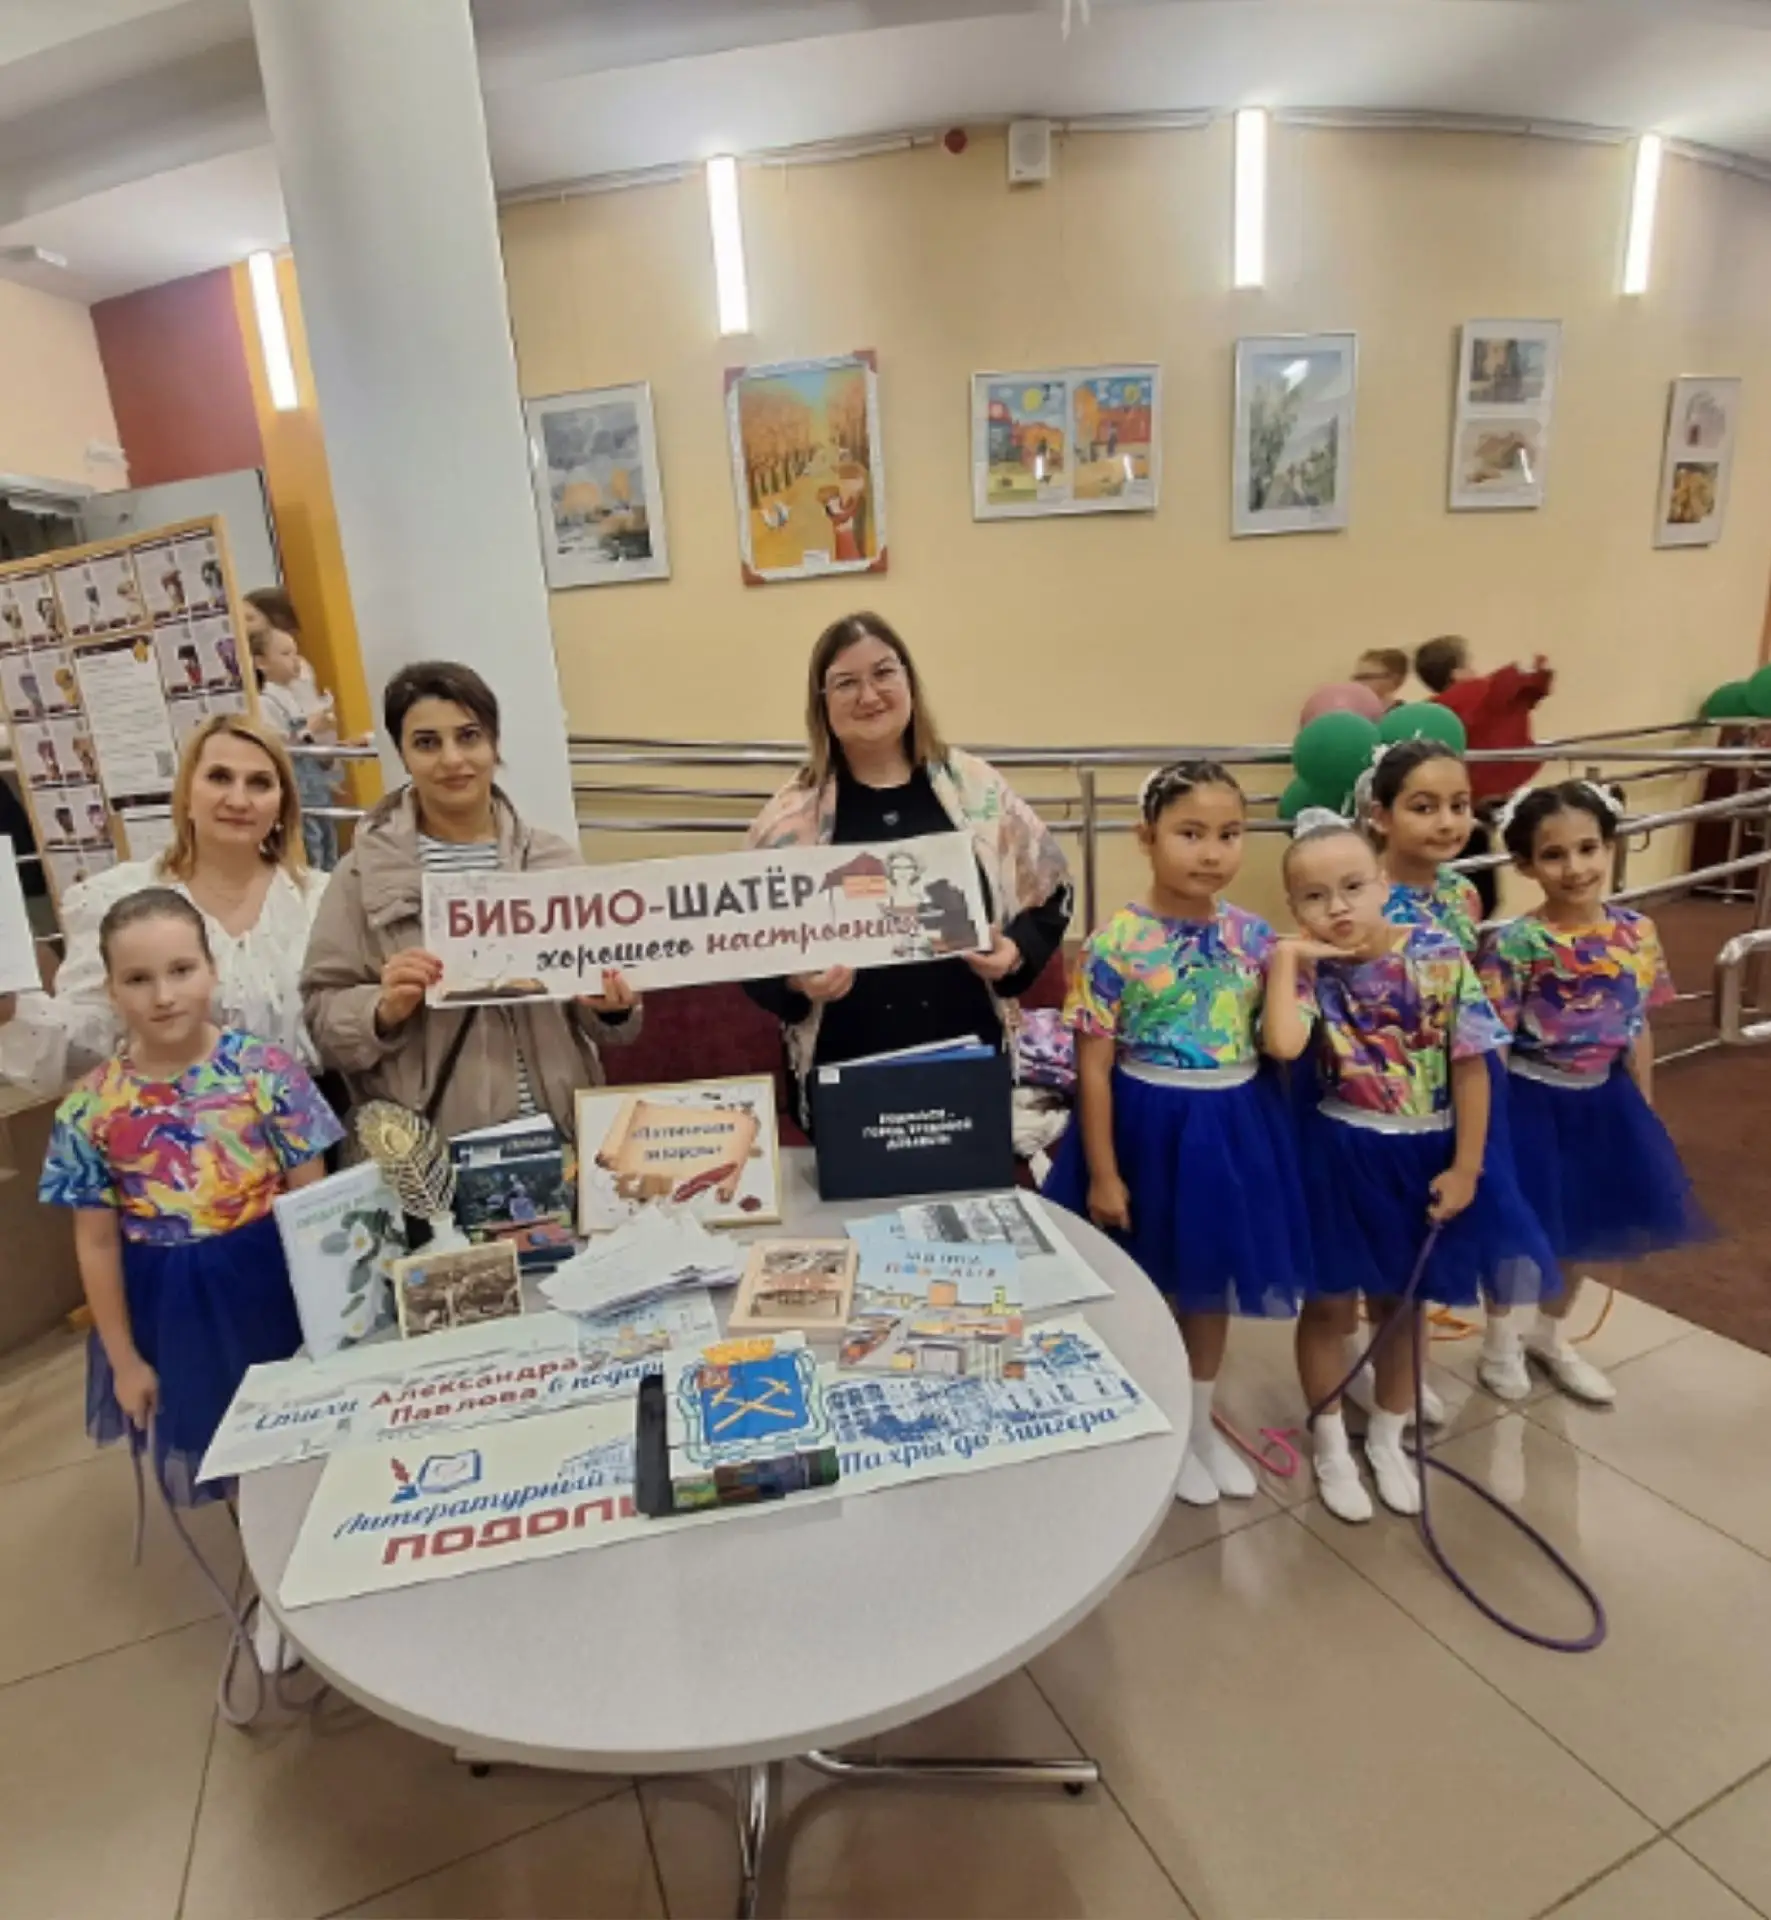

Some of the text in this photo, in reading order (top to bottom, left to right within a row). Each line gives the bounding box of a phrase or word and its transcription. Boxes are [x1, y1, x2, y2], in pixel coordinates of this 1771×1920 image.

[447, 867, 814, 938] БИБЛИО-ШАТЁР
[536, 937, 693, 978] хорошего
[370, 1356, 578, 1408] Александра
[390, 1387, 538, 1425] Павлова
[838, 1407, 1119, 1476] Пахры до Зингера
[333, 1470, 606, 1539] Литературный
